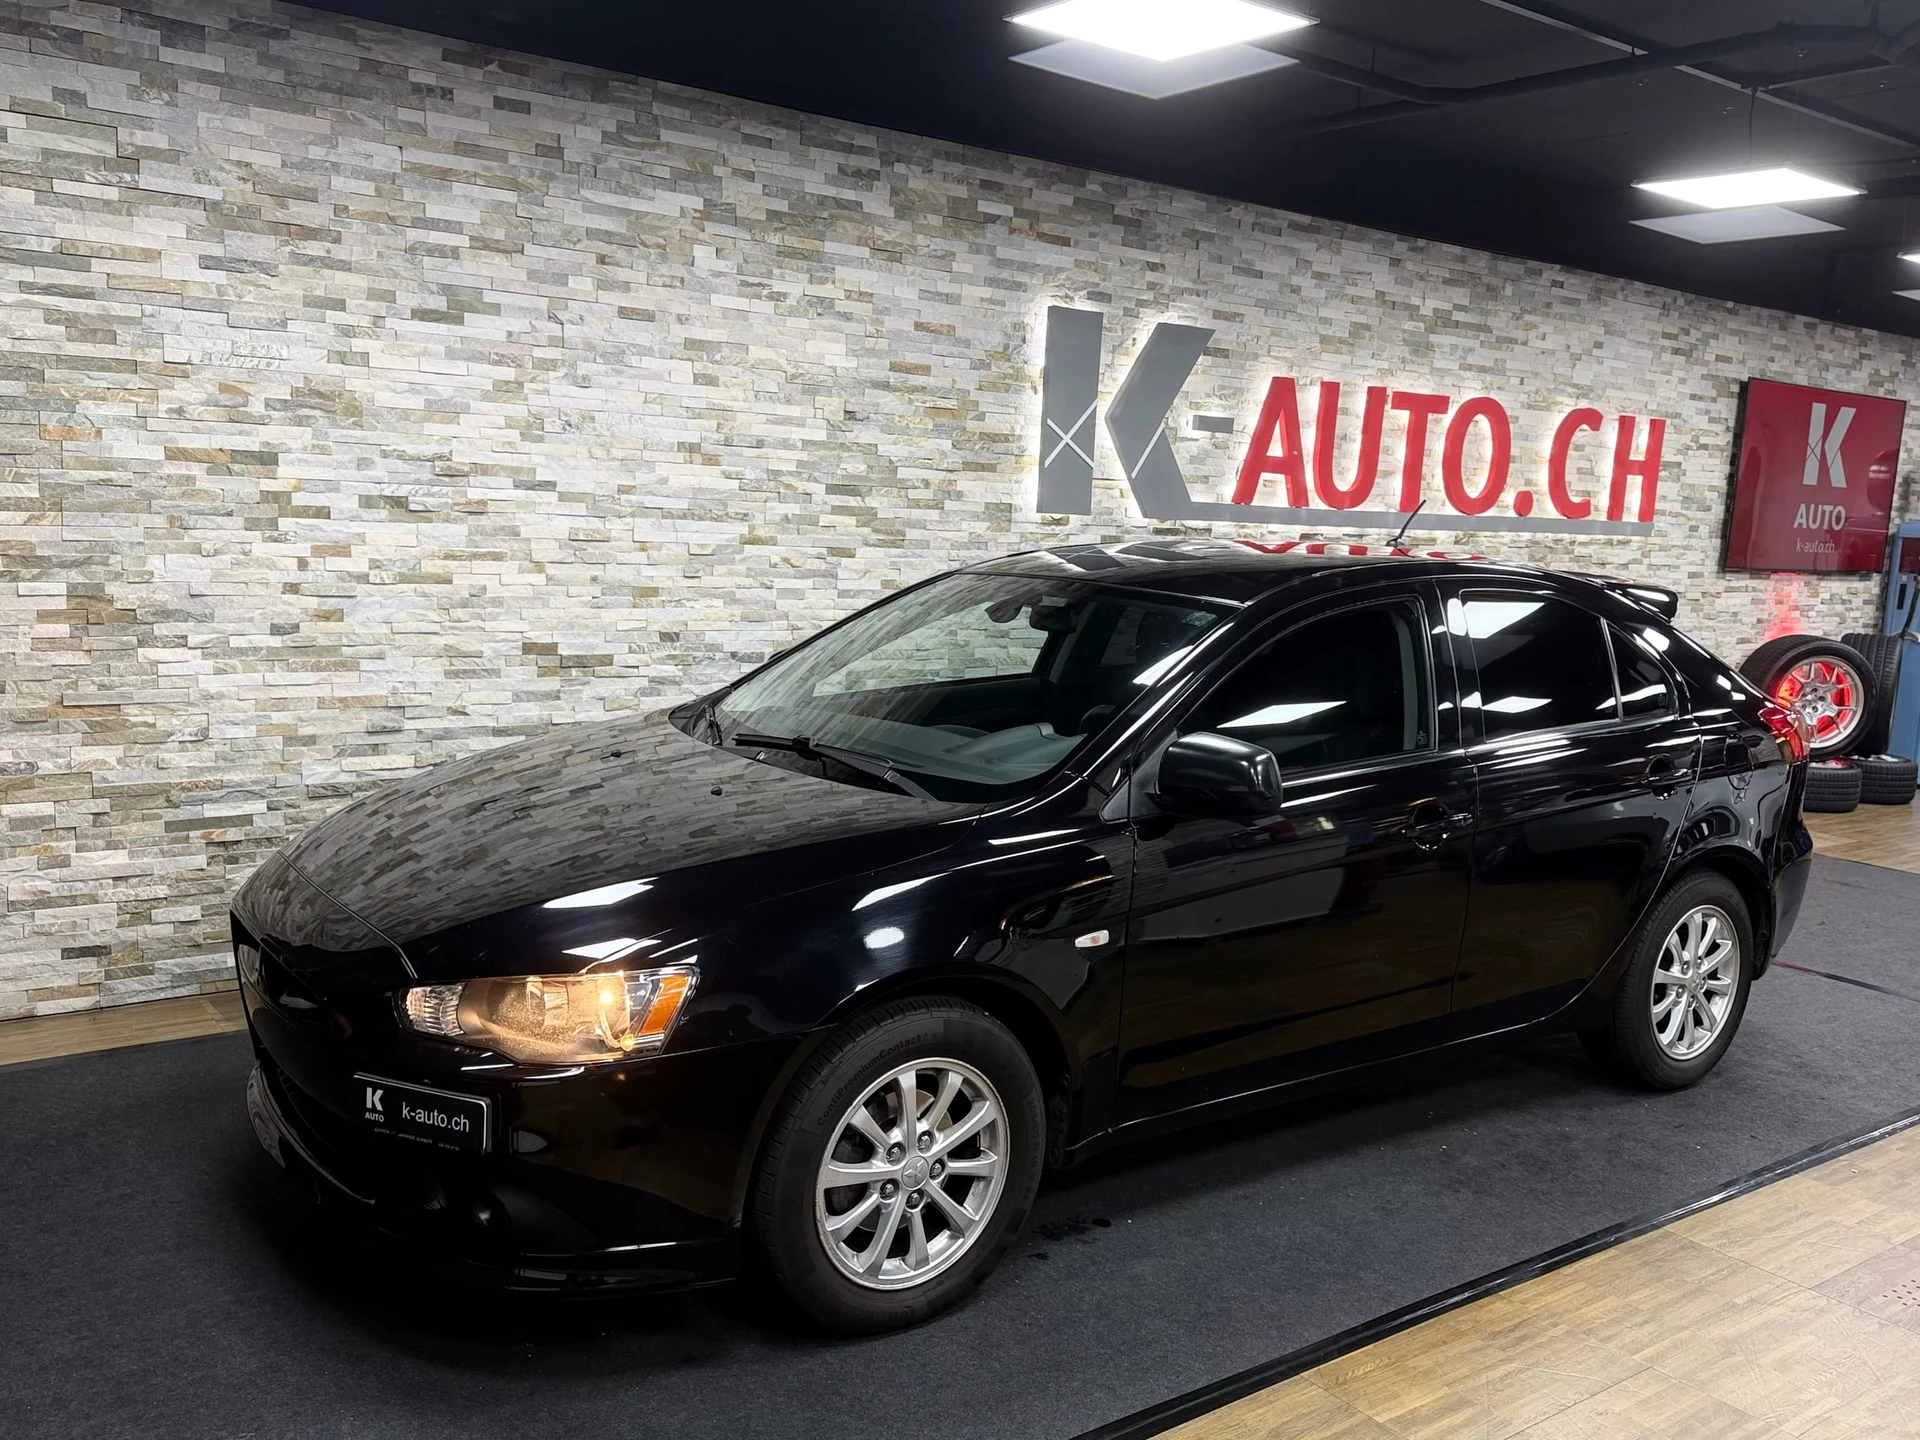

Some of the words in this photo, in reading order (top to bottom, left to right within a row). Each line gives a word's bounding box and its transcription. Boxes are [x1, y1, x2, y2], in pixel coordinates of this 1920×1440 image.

[1037, 305, 1666, 523] K-AUTO.CH
[1803, 402, 1857, 488] K
[1793, 503, 1846, 531] AUTO
[1795, 537, 1836, 554] k-auto.ch
[365, 1086, 384, 1112] K
[364, 1111, 385, 1123] AUTO
[401, 1101, 470, 1133] k-auto.ch
